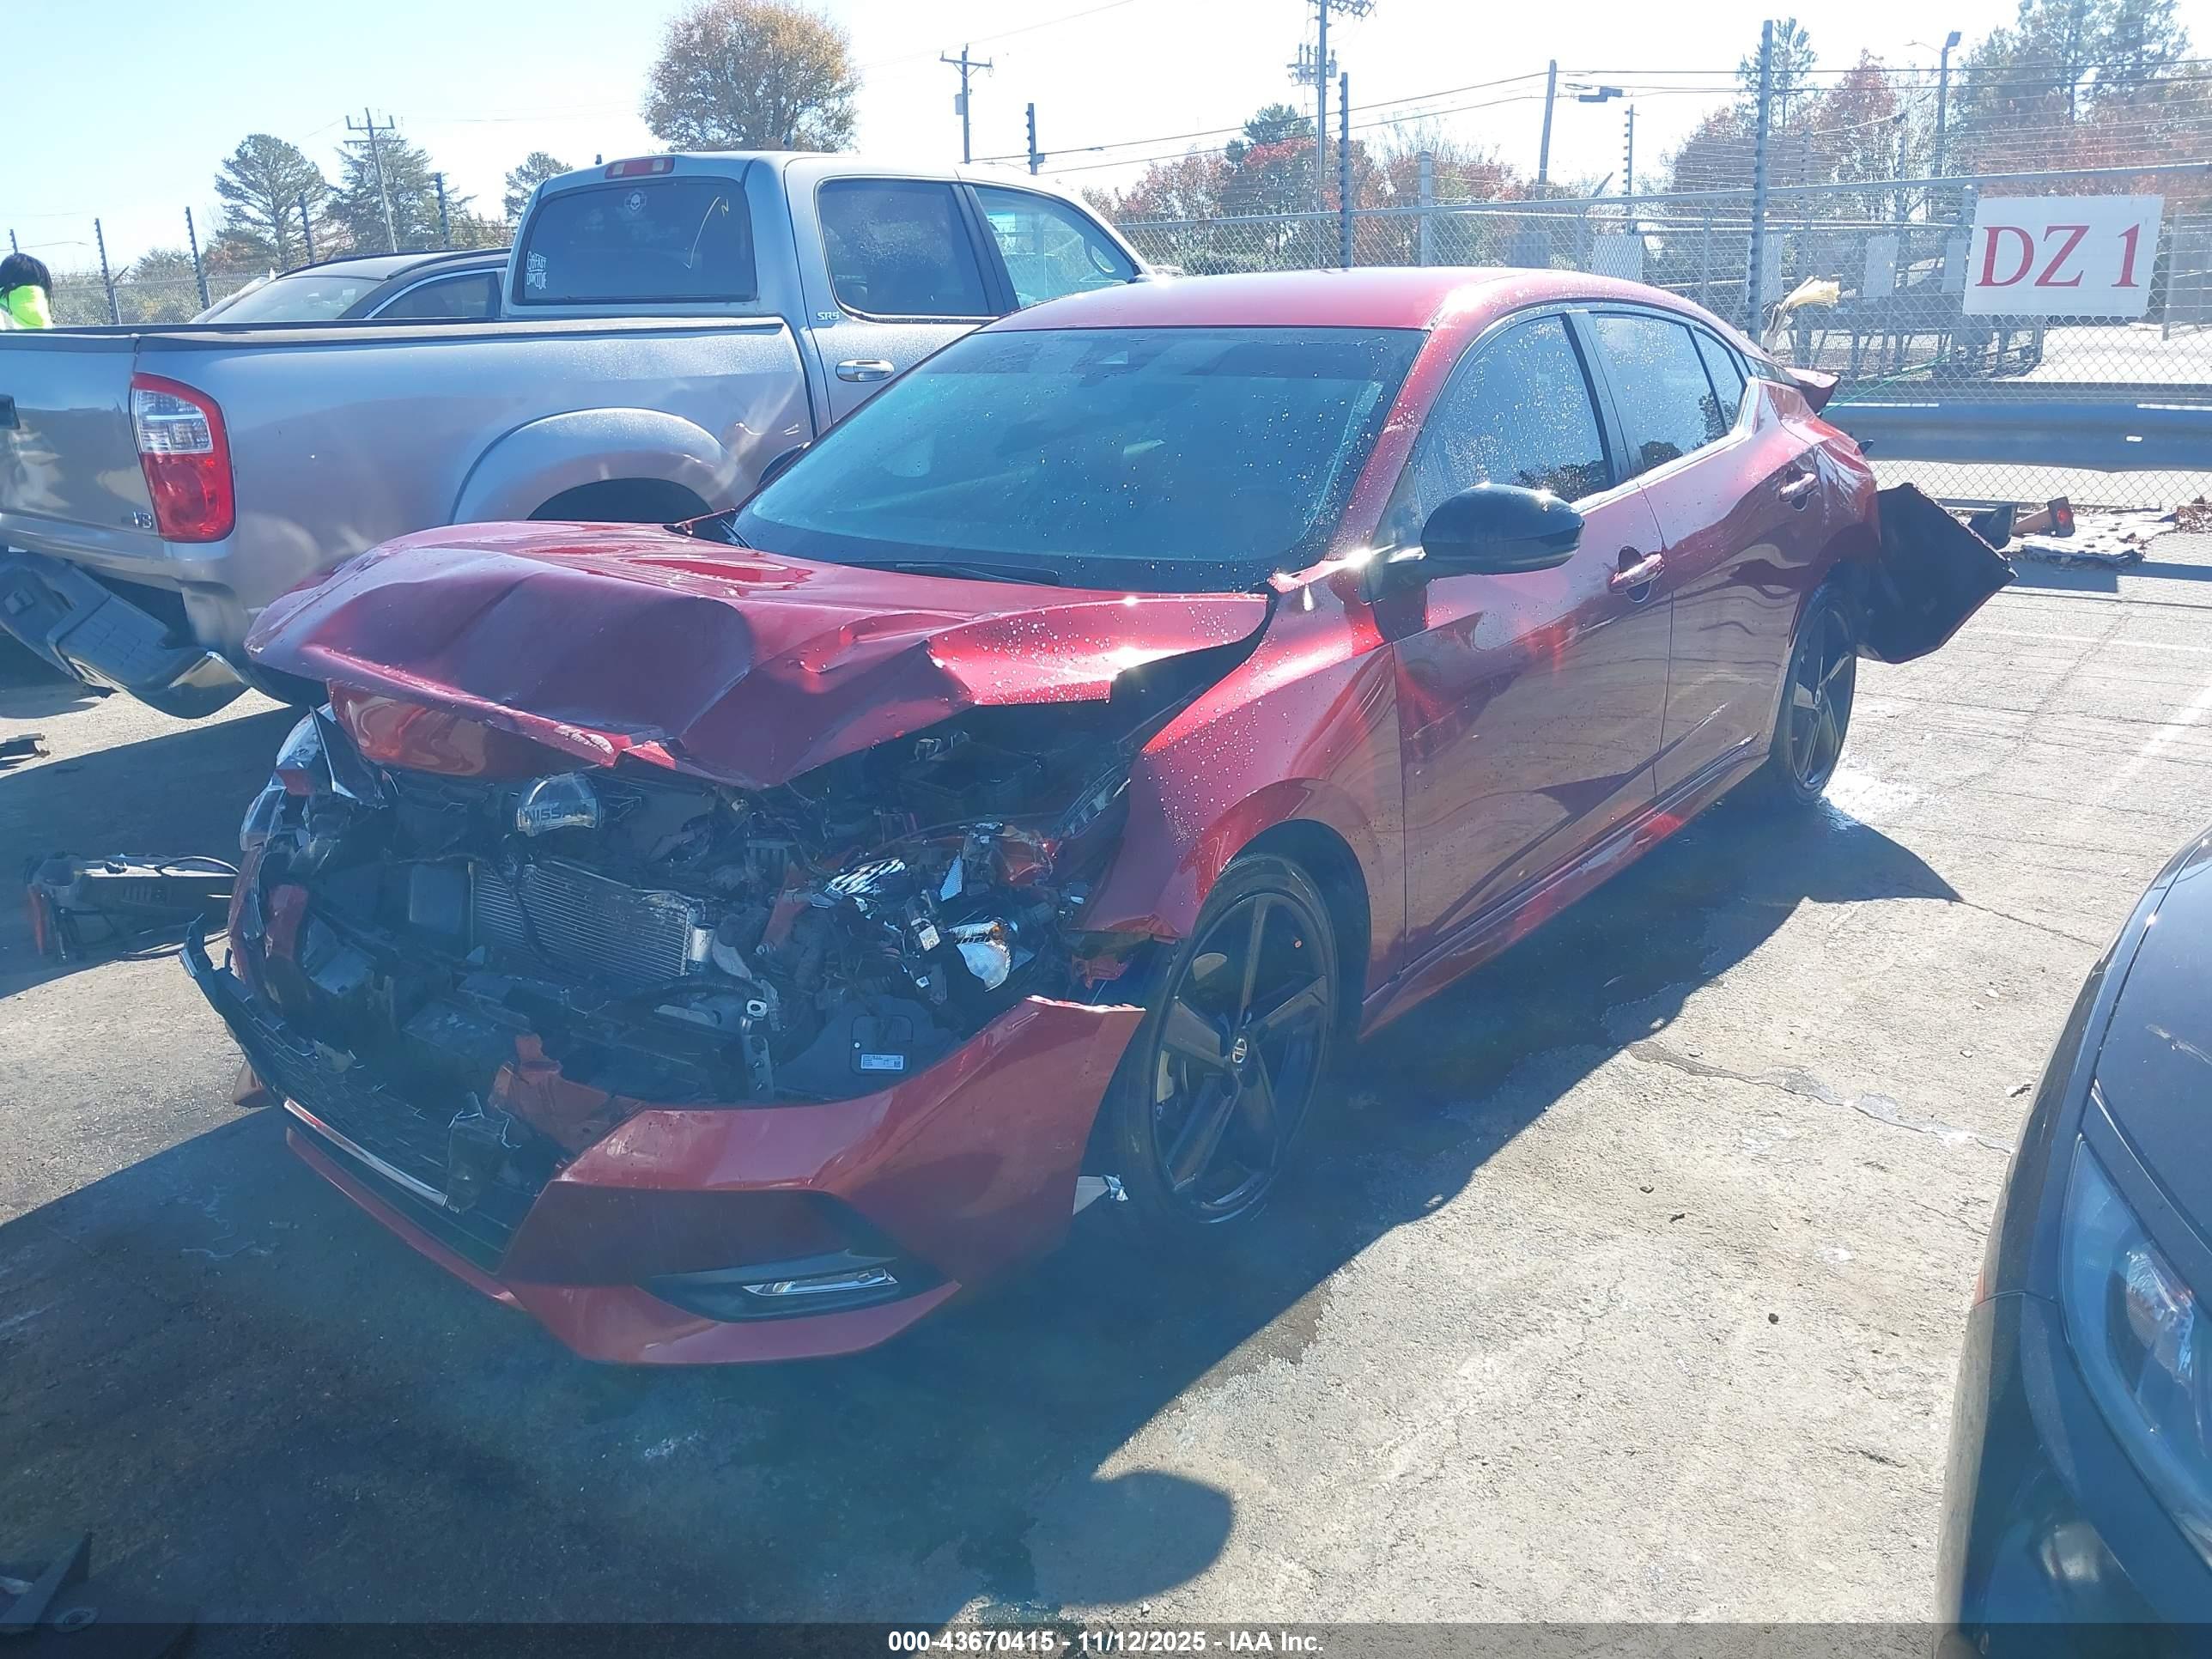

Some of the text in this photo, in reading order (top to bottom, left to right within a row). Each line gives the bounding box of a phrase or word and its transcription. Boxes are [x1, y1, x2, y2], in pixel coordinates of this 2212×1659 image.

[1975, 223, 2140, 288] DZ 1
[817, 311, 840, 320] SR5
